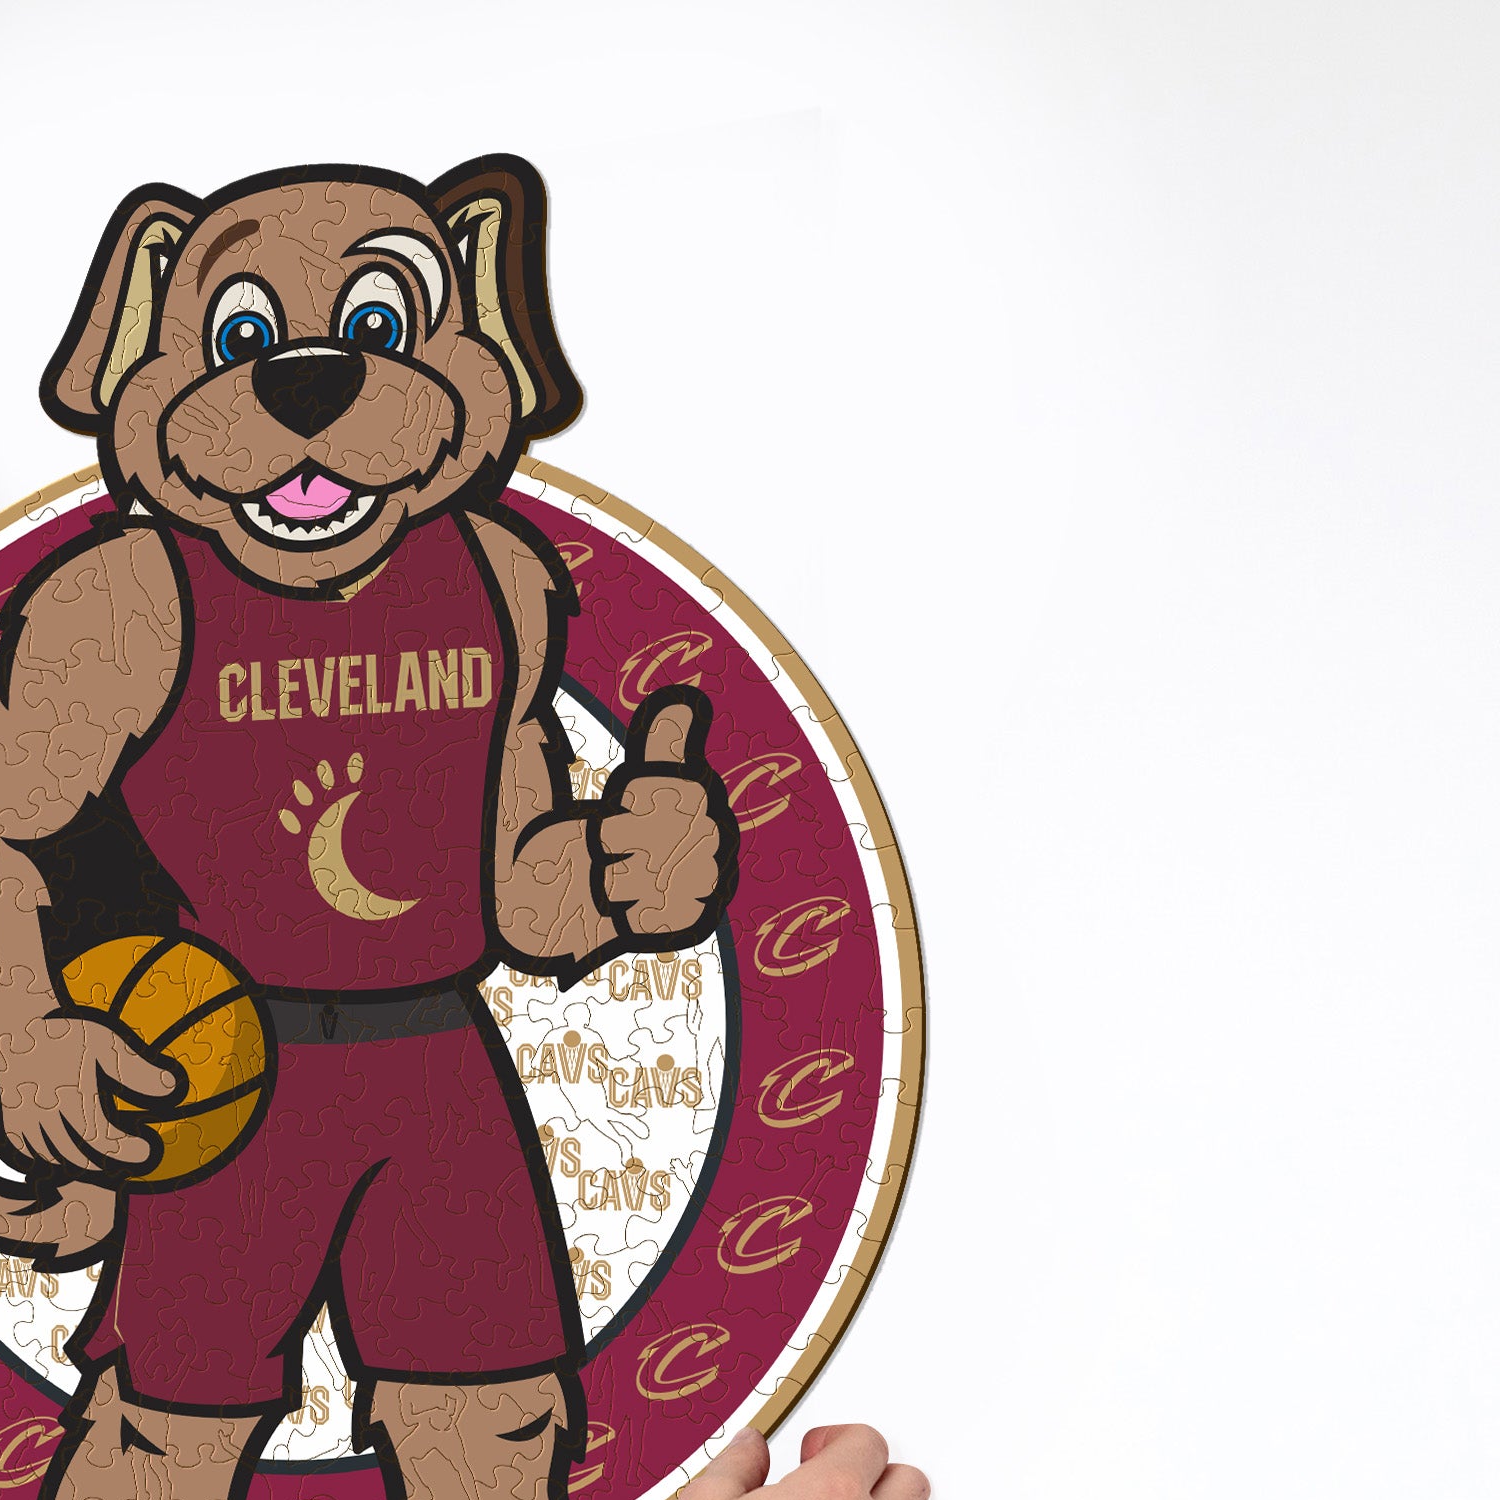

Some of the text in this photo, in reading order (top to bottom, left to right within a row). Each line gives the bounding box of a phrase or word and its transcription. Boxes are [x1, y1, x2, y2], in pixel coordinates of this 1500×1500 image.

[219, 648, 492, 722] CLEVELAND
[608, 959, 703, 1001] CAVS
[516, 1042, 609, 1085] CAVS
[608, 1066, 703, 1109] CAVS
[577, 1169, 671, 1212] CAVS
